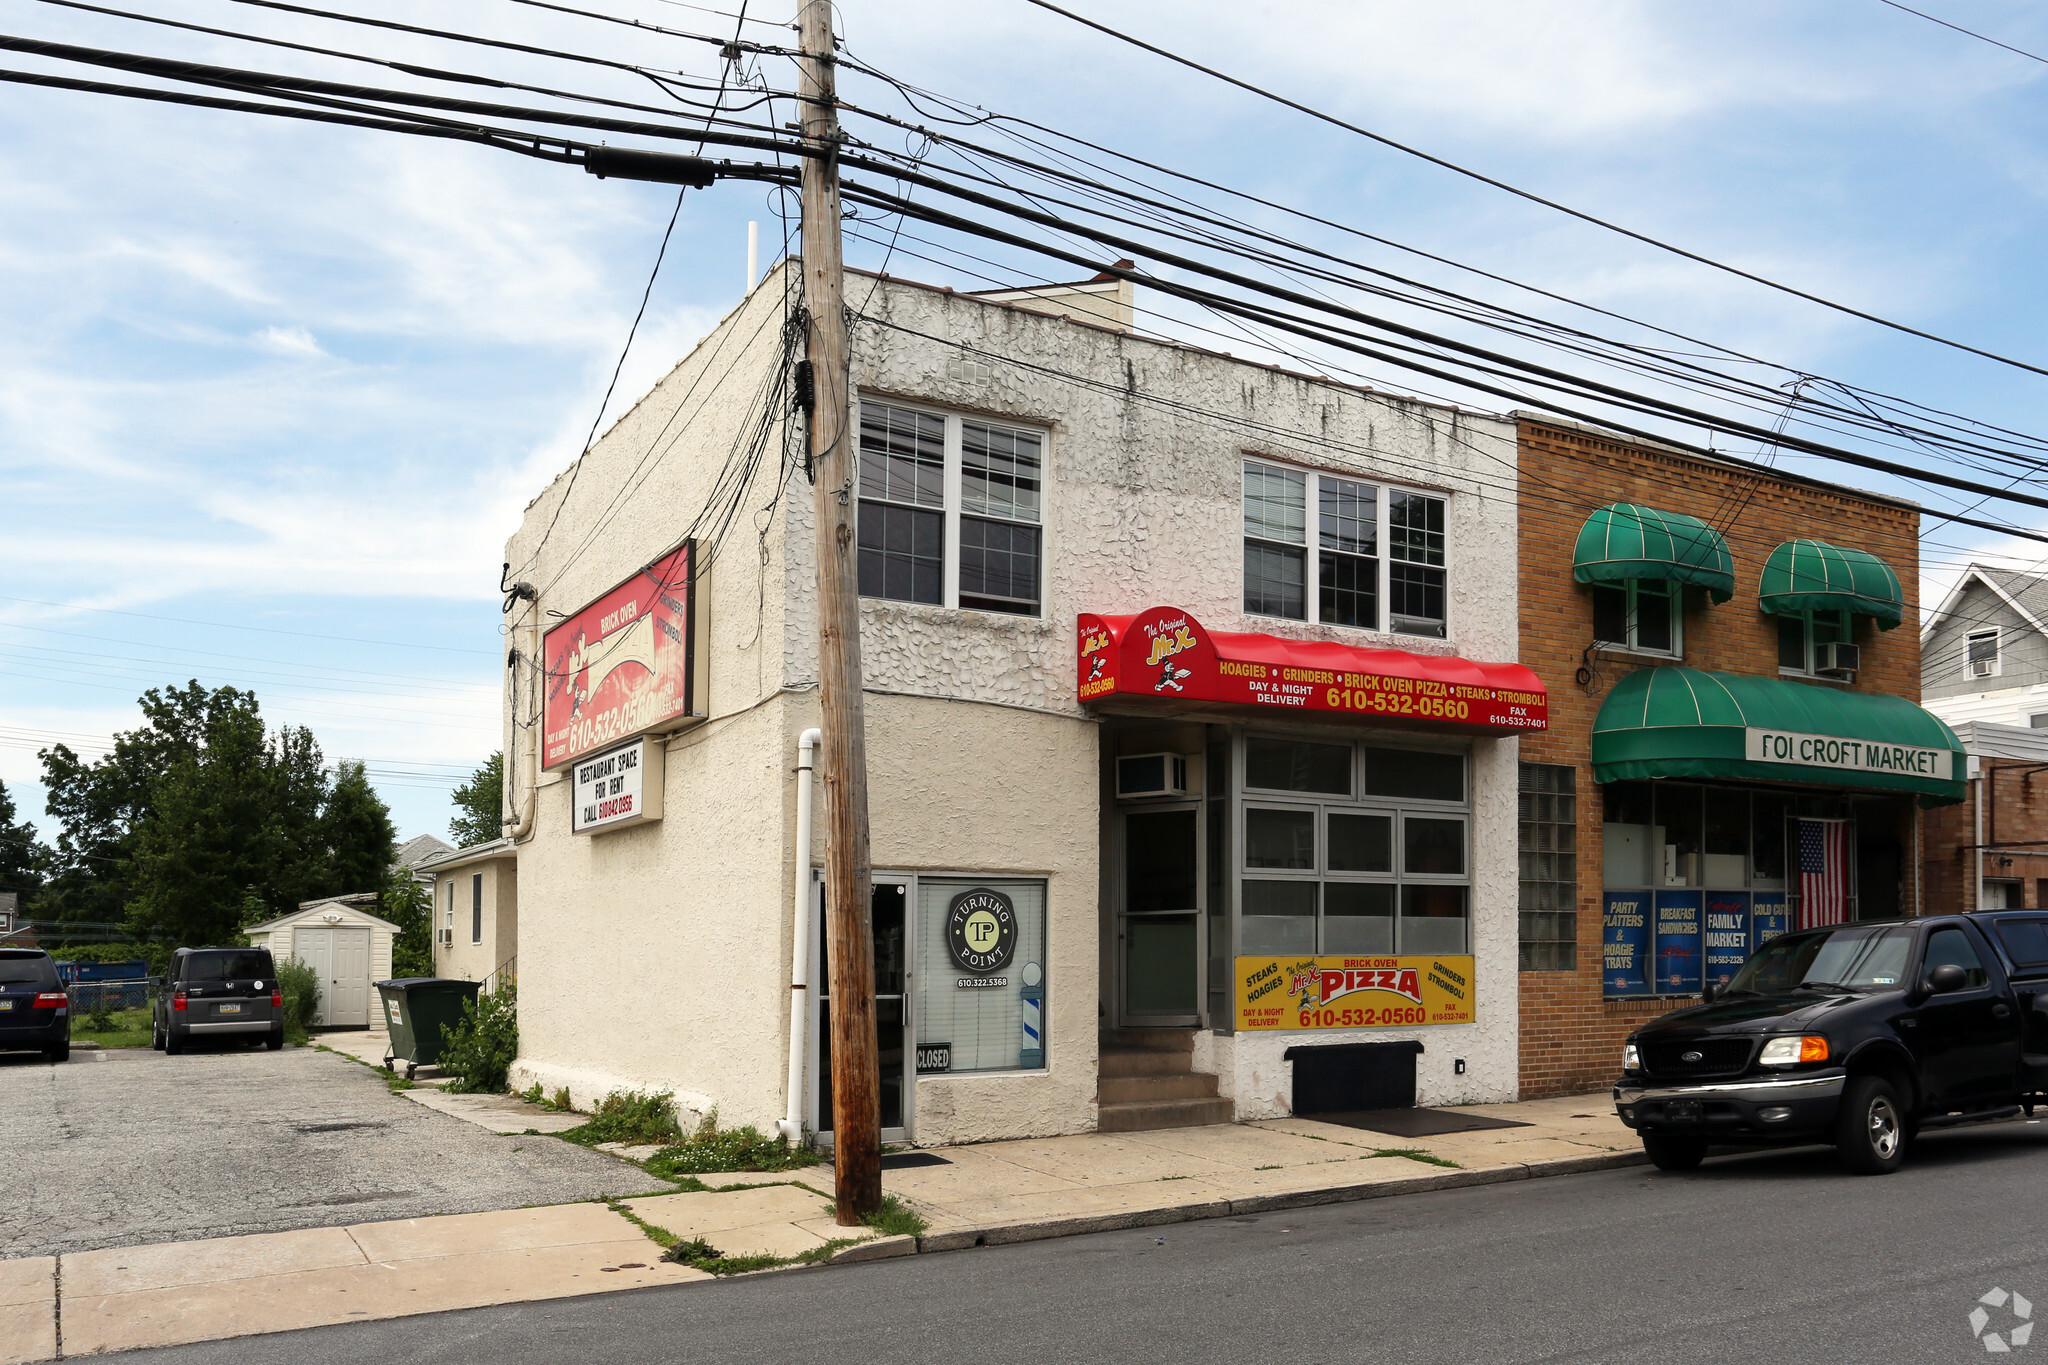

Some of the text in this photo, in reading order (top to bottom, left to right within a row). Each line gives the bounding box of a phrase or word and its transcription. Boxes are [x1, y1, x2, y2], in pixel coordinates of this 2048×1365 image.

[600, 600, 637, 634] BRICK OVEN
[1144, 615, 1186, 638] The Original
[1080, 677, 1115, 697] 610-532-0560
[1219, 662, 1545, 706] HOAGIES GRINDERS BRICK OVEN PIZZA STEAKS STROMBOLI
[1249, 681, 1313, 695] DAY & NIGHT
[1257, 693, 1305, 705] DELIVERY
[1326, 688, 1469, 720] 610-532-0560
[1510, 706, 1527, 716] FAX
[1490, 715, 1546, 728] 610-532-7401
[1866, 744, 1938, 774] MARKET
[580, 750, 637, 785] RESTAURANT SPACE
[595, 776, 624, 800] FOR RENT
[584, 805, 597, 823] CALL
[954, 896, 1010, 923] TURNING
[1610, 902, 1638, 914] PARTY
[1660, 908, 1696, 920] BREAKFAST
[1754, 904, 1772, 915] COLD
[1603, 915, 1643, 927] PLATTERS
[1658, 922, 1698, 935] SANDWICHES
[1708, 914, 1743, 929] FAMILY
[1769, 916, 1776, 927] &
[1616, 929, 1624, 942] &
[1706, 932, 1746, 947] MARKET
[961, 946, 1004, 967] POINT
[1603, 944, 1635, 956] HOAGIE
[1286, 957, 1315, 976] The Original
[1344, 959, 1397, 967] BRICK OVEN
[1605, 957, 1633, 969] TRAYS
[1708, 956, 1744, 964] 610-583-2326
[1246, 963, 1278, 987] STEAKS
[1433, 961, 1466, 986] GRINDERS
[957, 978, 1008, 988] 610.322.5368
[1247, 976, 1283, 1003] HOAGIES
[1320, 969, 1422, 1004] PIZZA
[1428, 972, 1465, 1000] STROMBOLI
[1243, 1008, 1284, 1017] DAY & NIGHT
[1299, 1007, 1426, 1027] 610-532-0560
[1432, 1013, 1468, 1021] 610-532-7401
[1248, 1018, 1279, 1026] DELIVERY
[917, 1049, 949, 1068] CLOSED
